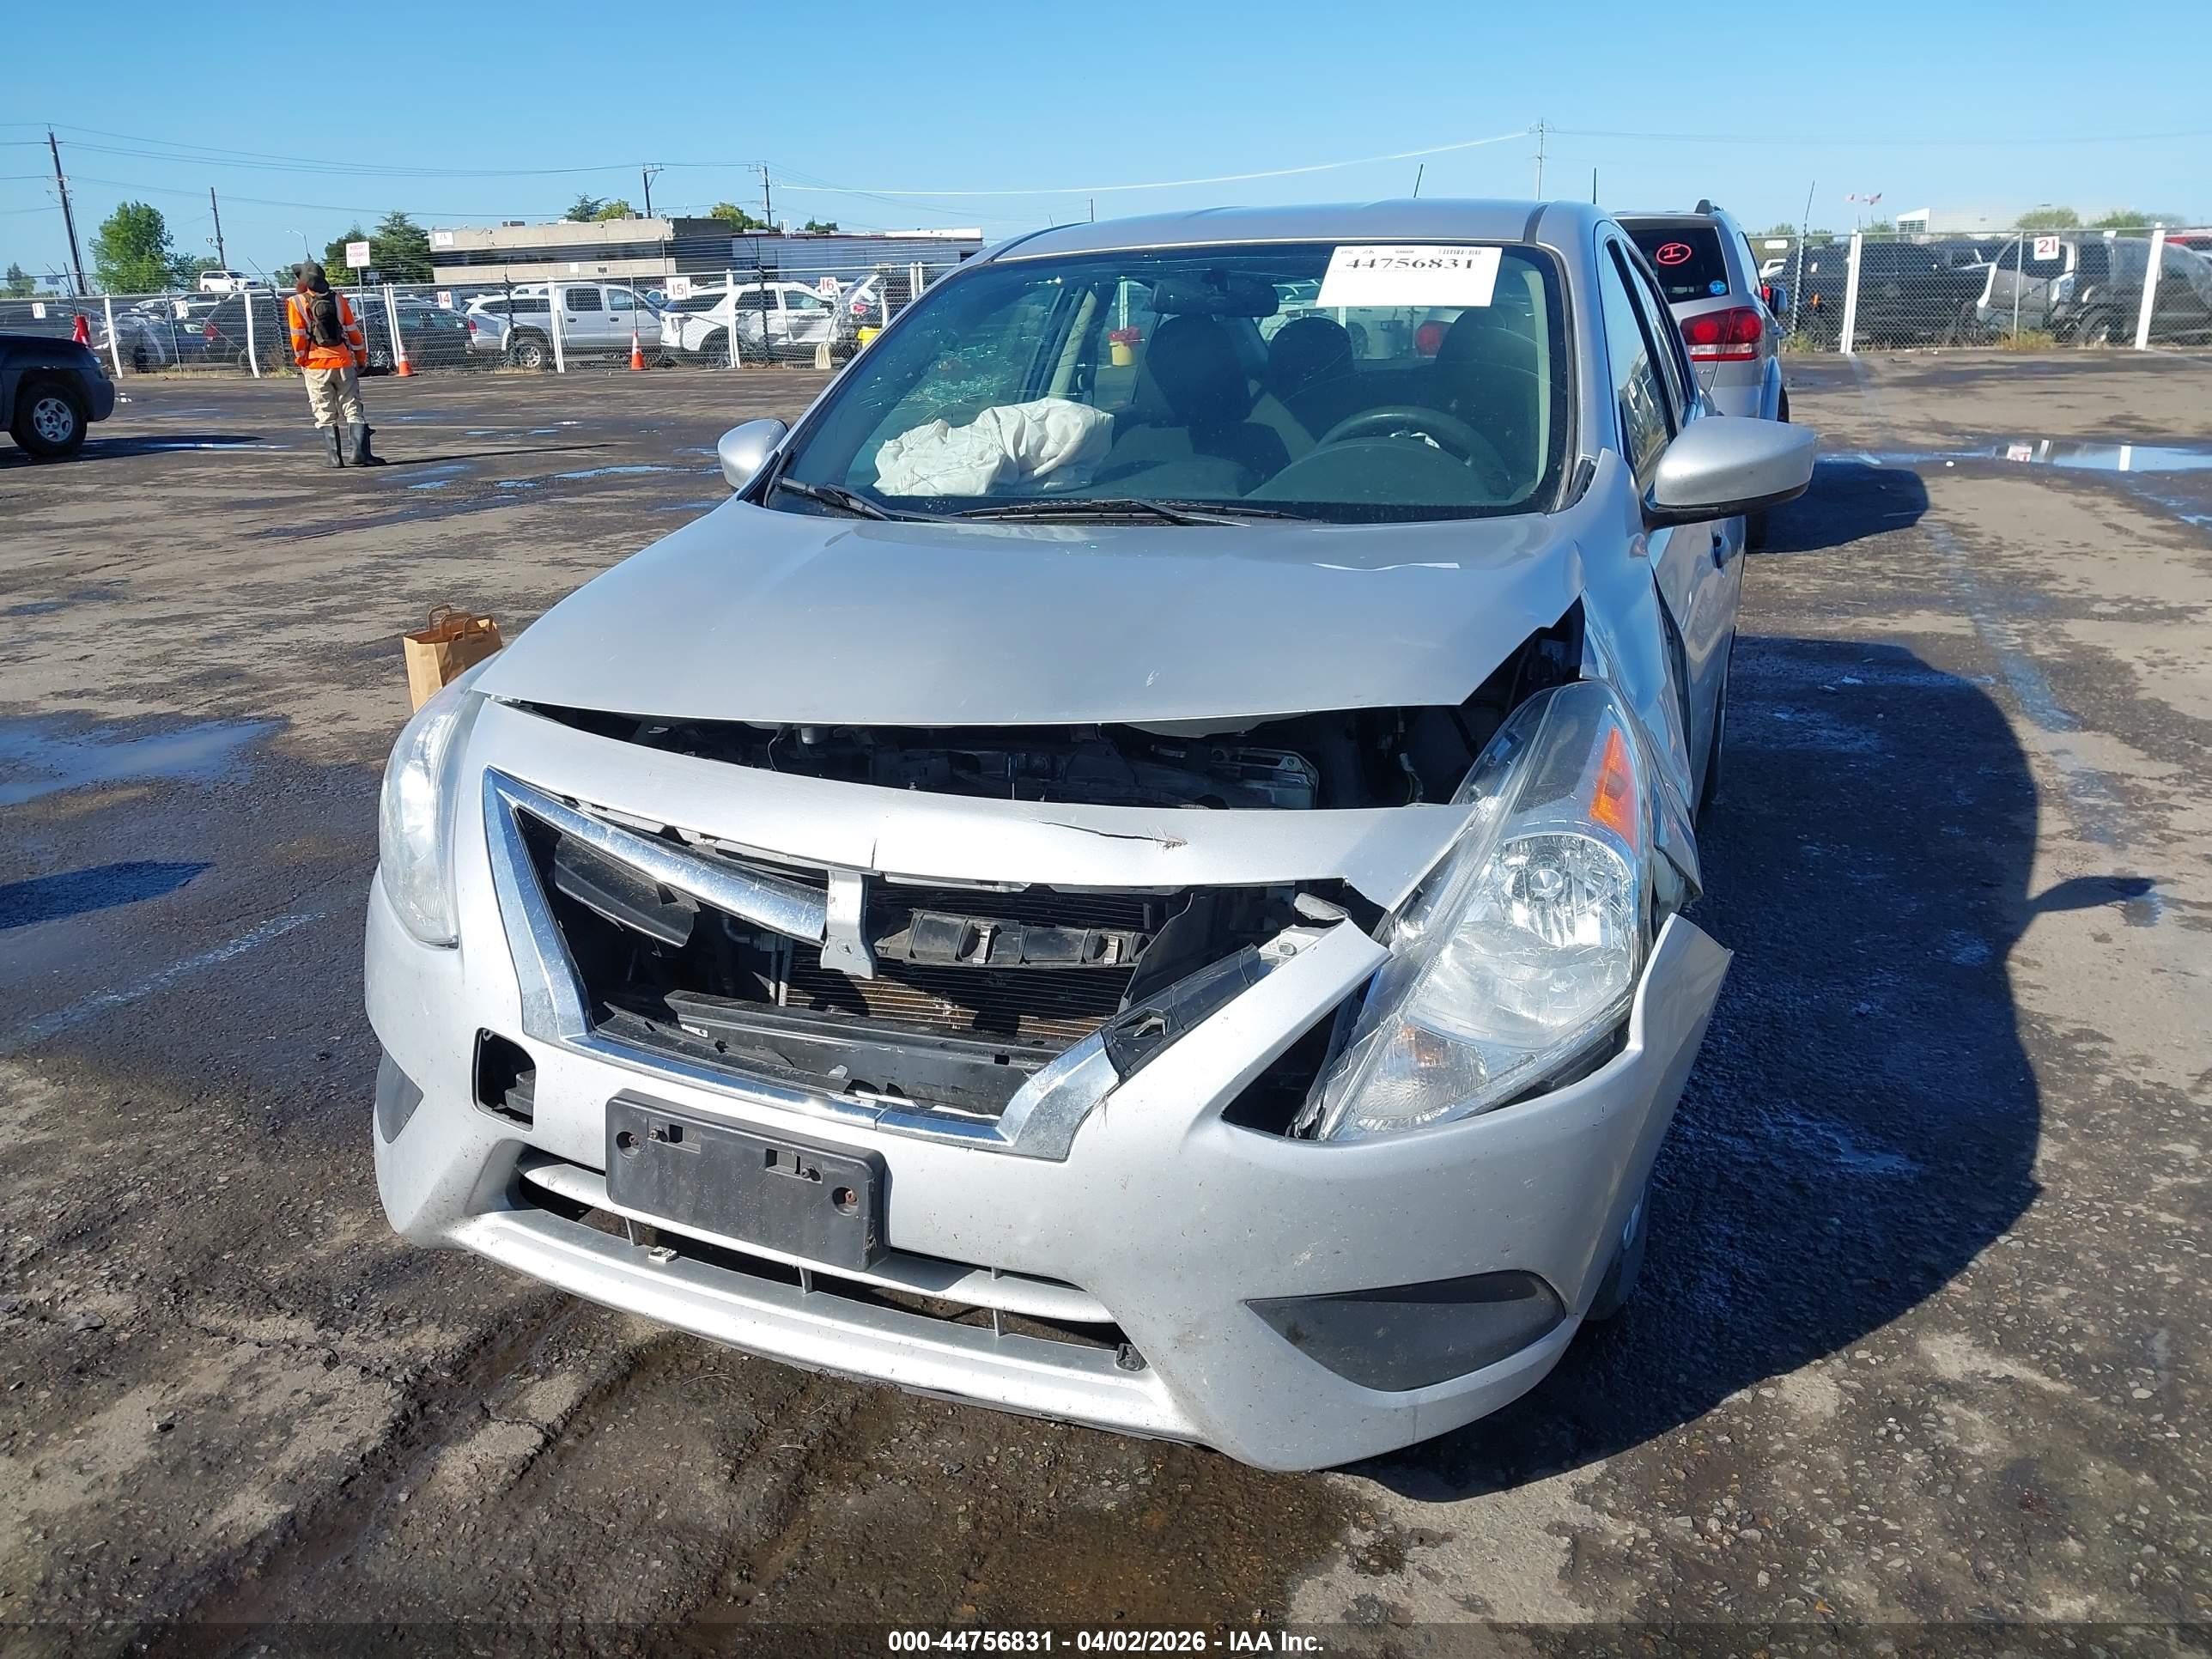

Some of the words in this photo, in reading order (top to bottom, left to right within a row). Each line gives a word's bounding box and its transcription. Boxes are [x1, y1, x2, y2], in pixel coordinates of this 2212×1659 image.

[2038, 239, 2056, 253] 21
[1346, 258, 1474, 269] 44756831
[672, 283, 684, 295] 15
[822, 278, 834, 290] 16
[439, 293, 451, 304] 14
